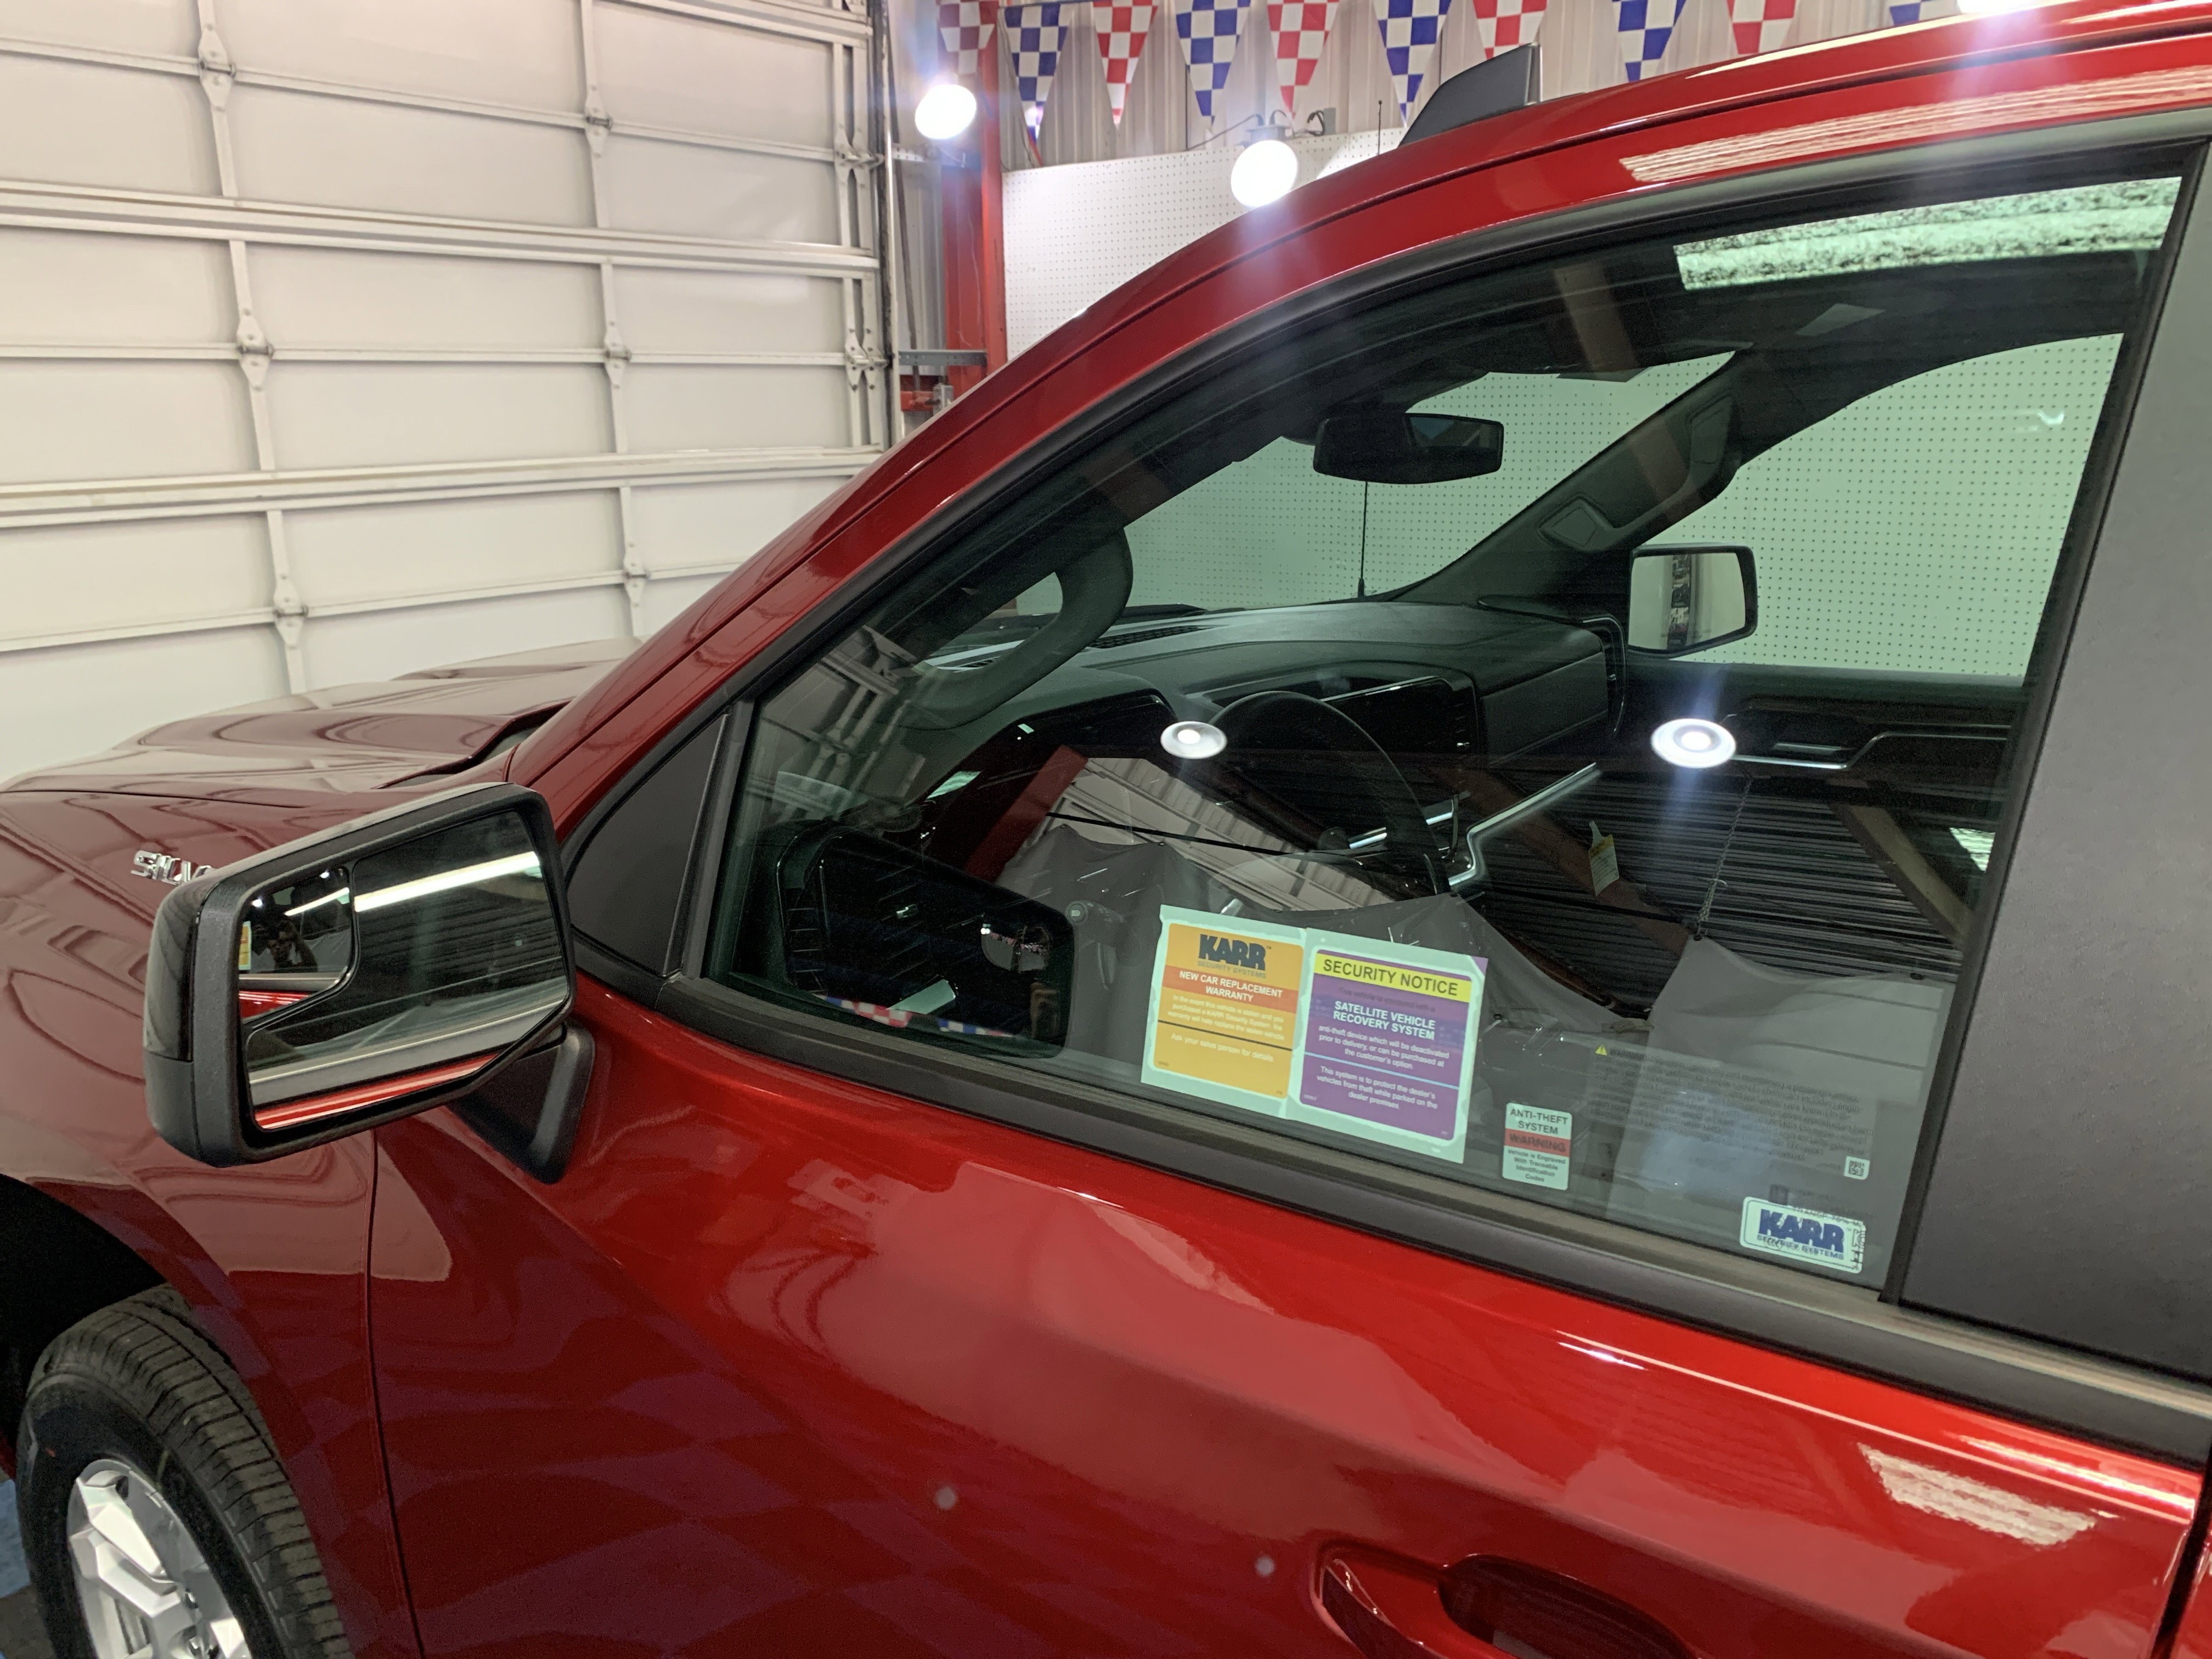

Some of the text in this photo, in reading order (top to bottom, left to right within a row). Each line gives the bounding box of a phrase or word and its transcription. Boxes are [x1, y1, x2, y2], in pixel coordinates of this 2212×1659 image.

[1198, 934, 1266, 970] KARR
[1198, 960, 1266, 979] SECURITY SYSTEMS
[1323, 959, 1458, 996] SECURITY NOTICE
[1180, 970, 1283, 997] NEW CAR REPLACEMENT
[1205, 986, 1254, 1002] WARRANTY
[1207, 1010, 1224, 1018] KARR
[1226, 1013, 1248, 1025] Security
[1333, 1011, 1435, 1040] RECOVERY SYSTEM
[1335, 1001, 1436, 1030] SATELLITE VEHICLE
[1171, 1033, 1183, 1041] Ask
[1184, 1036, 1198, 1045] your
[1200, 1040, 1217, 1049] sales
[1218, 1043, 1240, 1054] person
[1318, 1025, 1346, 1036] anti-theft
[1347, 1031, 1368, 1040] device
[1369, 1036, 1387, 1045] which
[1401, 1042, 1409, 1050] be
[1410, 1045, 1449, 1059] deactivated
[1345, 1048, 1355, 1056] the
[1401, 1053, 1436, 1065] purchased
[1321, 1065, 1334, 1075] This
[1335, 1071, 1358, 1081] system
[1373, 1080, 1396, 1090] protect
[1397, 1085, 1408, 1093] the
[1317, 1076, 1342, 1086] vehicles
[1343, 1080, 1358, 1090] from
[1358, 1085, 1373, 1093] theft
[1374, 1089, 1391, 1098] while
[1392, 1093, 1415, 1104] parked
[1426, 1101, 1438, 1109] the
[1348, 1091, 1369, 1101] dealer
[1510, 1108, 1568, 1125] ANTI-THEFT
[1518, 1120, 1559, 1135] SYSTEM
[1509, 1133, 1566, 1153] WARNING
[1537, 1154, 1566, 1164] Engraved
[1525, 1173, 1544, 1182] Codes
[1759, 1209, 1844, 1253] KARR
